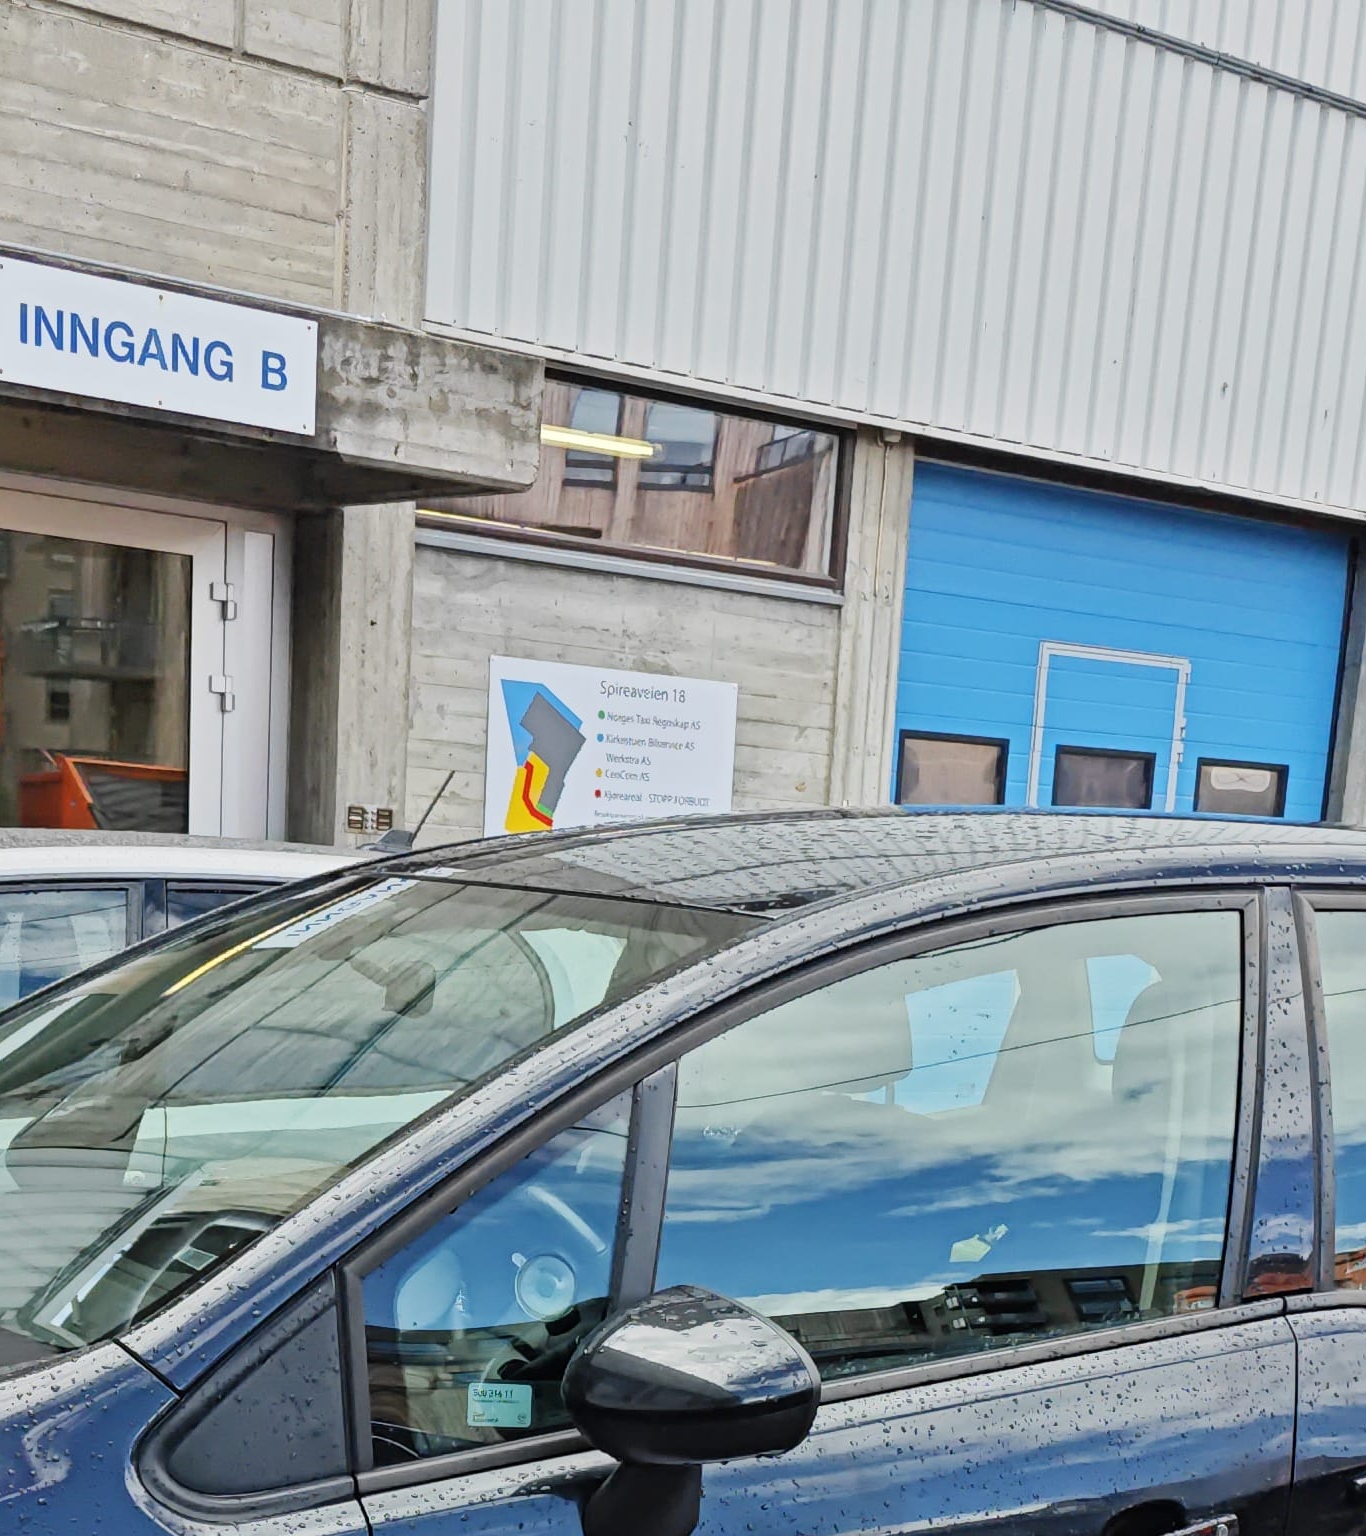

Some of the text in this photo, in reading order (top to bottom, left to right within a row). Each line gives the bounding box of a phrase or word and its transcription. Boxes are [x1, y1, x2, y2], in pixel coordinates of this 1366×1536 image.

[19, 302, 288, 392] INNGANG B
[599, 680, 686, 703] Spireaveien 18
[690, 719, 702, 730] AS
[641, 756, 652, 766] AS
